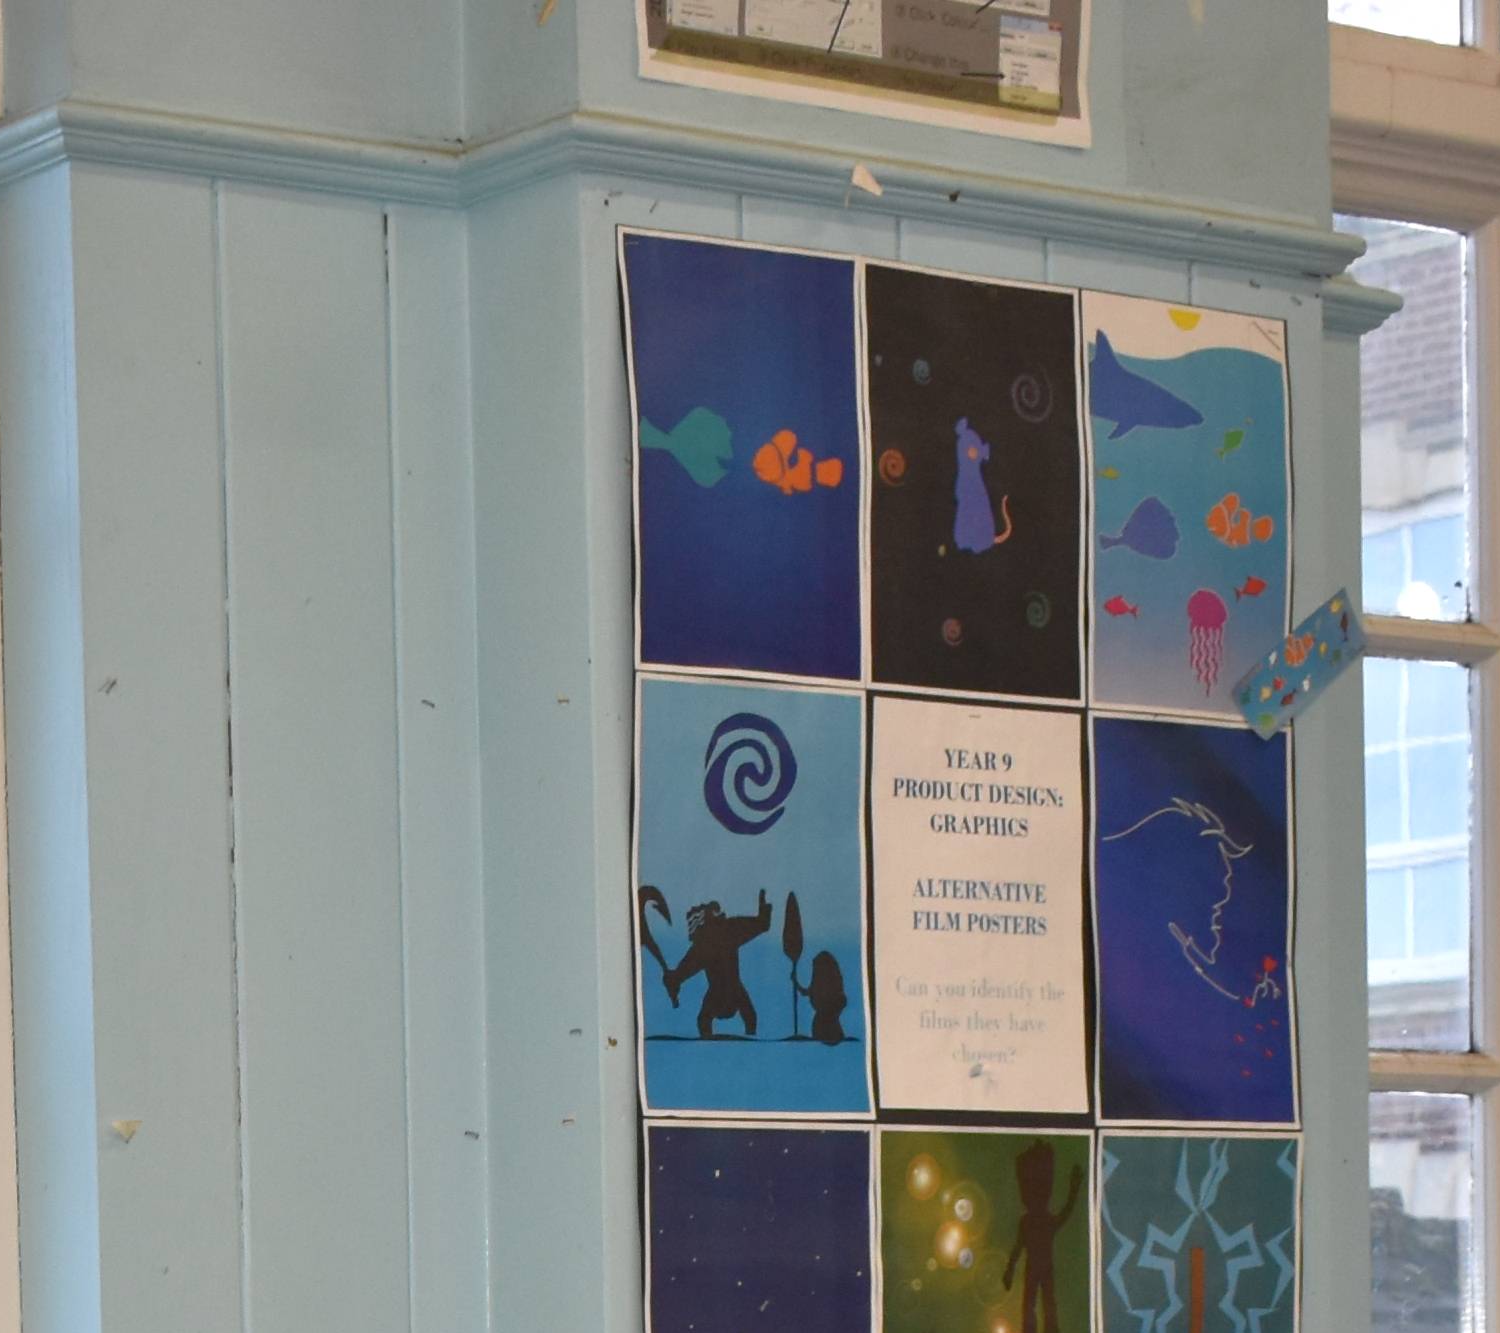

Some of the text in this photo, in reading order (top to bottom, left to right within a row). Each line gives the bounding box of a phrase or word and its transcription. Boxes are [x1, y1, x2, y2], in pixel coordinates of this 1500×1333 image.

[944, 748, 1013, 772] YEAR 9
[892, 777, 1064, 808] PRODUCT DESIGN:
[929, 813, 1029, 838] GRAPHICS
[912, 877, 1046, 904] ALTERNATIVE
[912, 910, 1048, 936] FILM POSTERS
[896, 975, 1065, 1004] Can you identify the
[919, 1011, 1046, 1036] films they have
